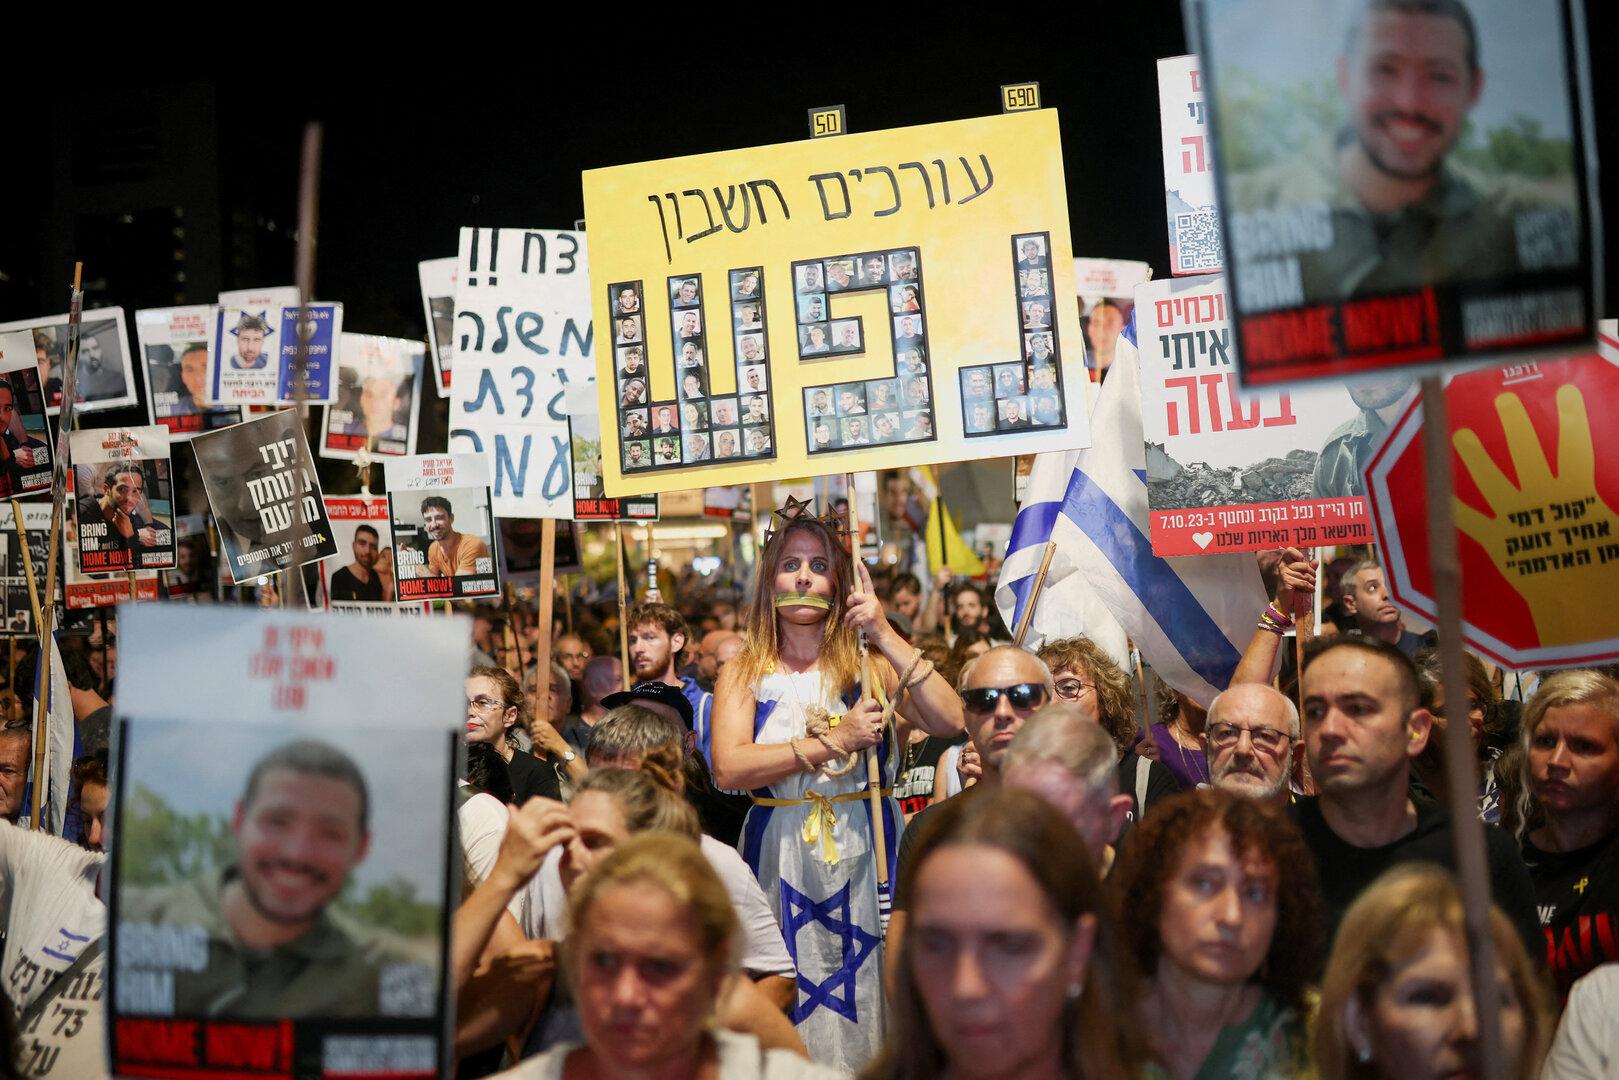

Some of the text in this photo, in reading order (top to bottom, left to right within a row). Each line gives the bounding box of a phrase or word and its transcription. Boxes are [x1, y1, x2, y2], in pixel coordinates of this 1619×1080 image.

[1008, 89, 1036, 107] 690
[816, 114, 838, 134] 50
[648, 154, 994, 264] עורכים חשבון
[521, 232, 579, 274] צח
[1155, 293, 1225, 328] וכחים
[458, 306, 593, 356] משלה
[1159, 328, 1230, 371] איתי
[576, 500, 597, 514] HOME
[600, 497, 620, 513] NOW!
[1292, 504, 1313, 520] נפל
[1349, 502, 1364, 519] חן
[259, 495, 321, 535] מעם
[1218, 509, 1255, 527] ונחטף
[1258, 506, 1288, 525] בקרב
[1506, 508, 1545, 528] דמי
[80, 522, 108, 538] BRING
[1216, 523, 1367, 547] ותישאר מלך האריות שלנו
[1504, 520, 1611, 557] אחיך זועק
[81, 537, 99, 551] HIM
[303, 533, 318, 548] העם
[83, 552, 107, 566] HOME
[109, 548, 133, 565] NOW!
[236, 549, 270, 567] החטופים
[269, 545, 282, 558] את
[398, 550, 425, 565] BRING
[398, 564, 417, 580] HIM
[400, 579, 425, 595] HOME
[427, 577, 453, 593] NOW!
[69, 596, 91, 607] Bring
[93, 593, 114, 604] Them
[138, 589, 154, 599] Now
